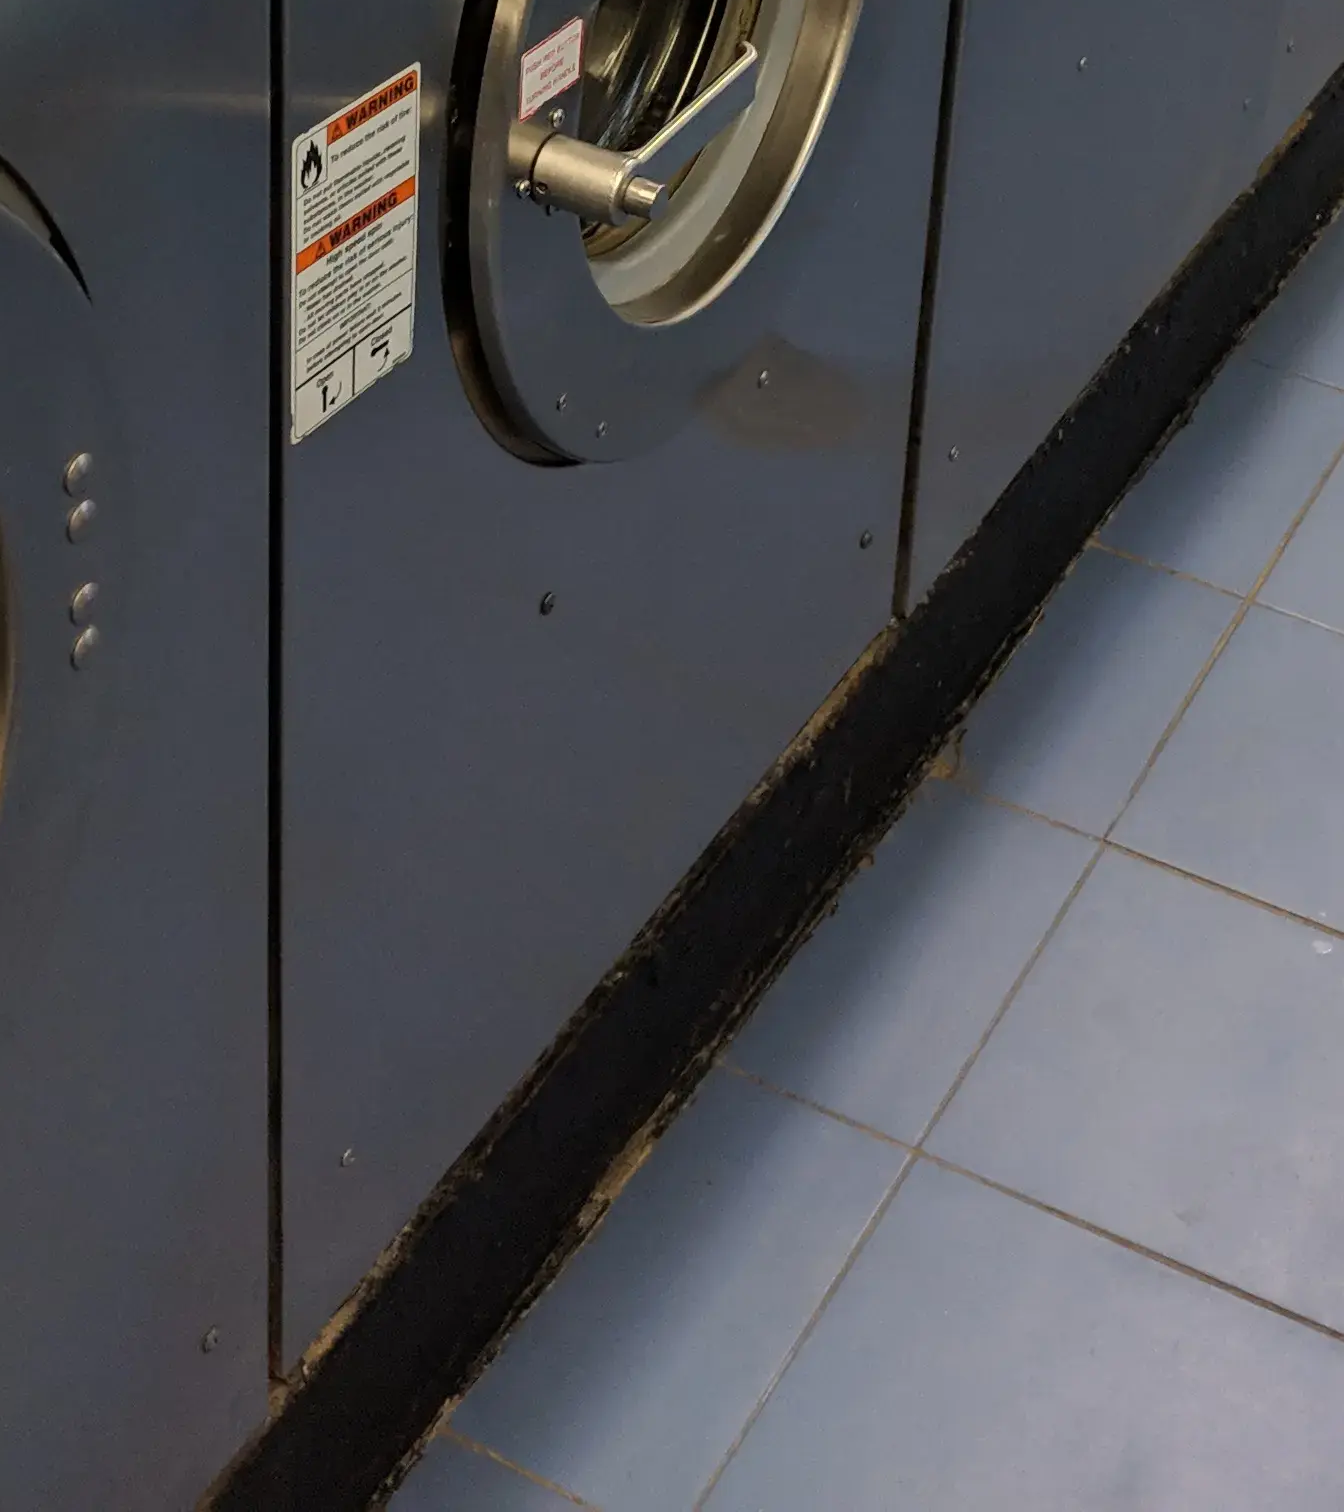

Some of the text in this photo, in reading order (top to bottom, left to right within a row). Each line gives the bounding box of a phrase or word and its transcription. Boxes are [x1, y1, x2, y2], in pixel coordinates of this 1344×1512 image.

[346, 74, 413, 131] WARNING
[329, 189, 397, 249] WARNING
[326, 248, 342, 267] High
[371, 323, 392, 347] Closed
[316, 368, 333, 389] Open
